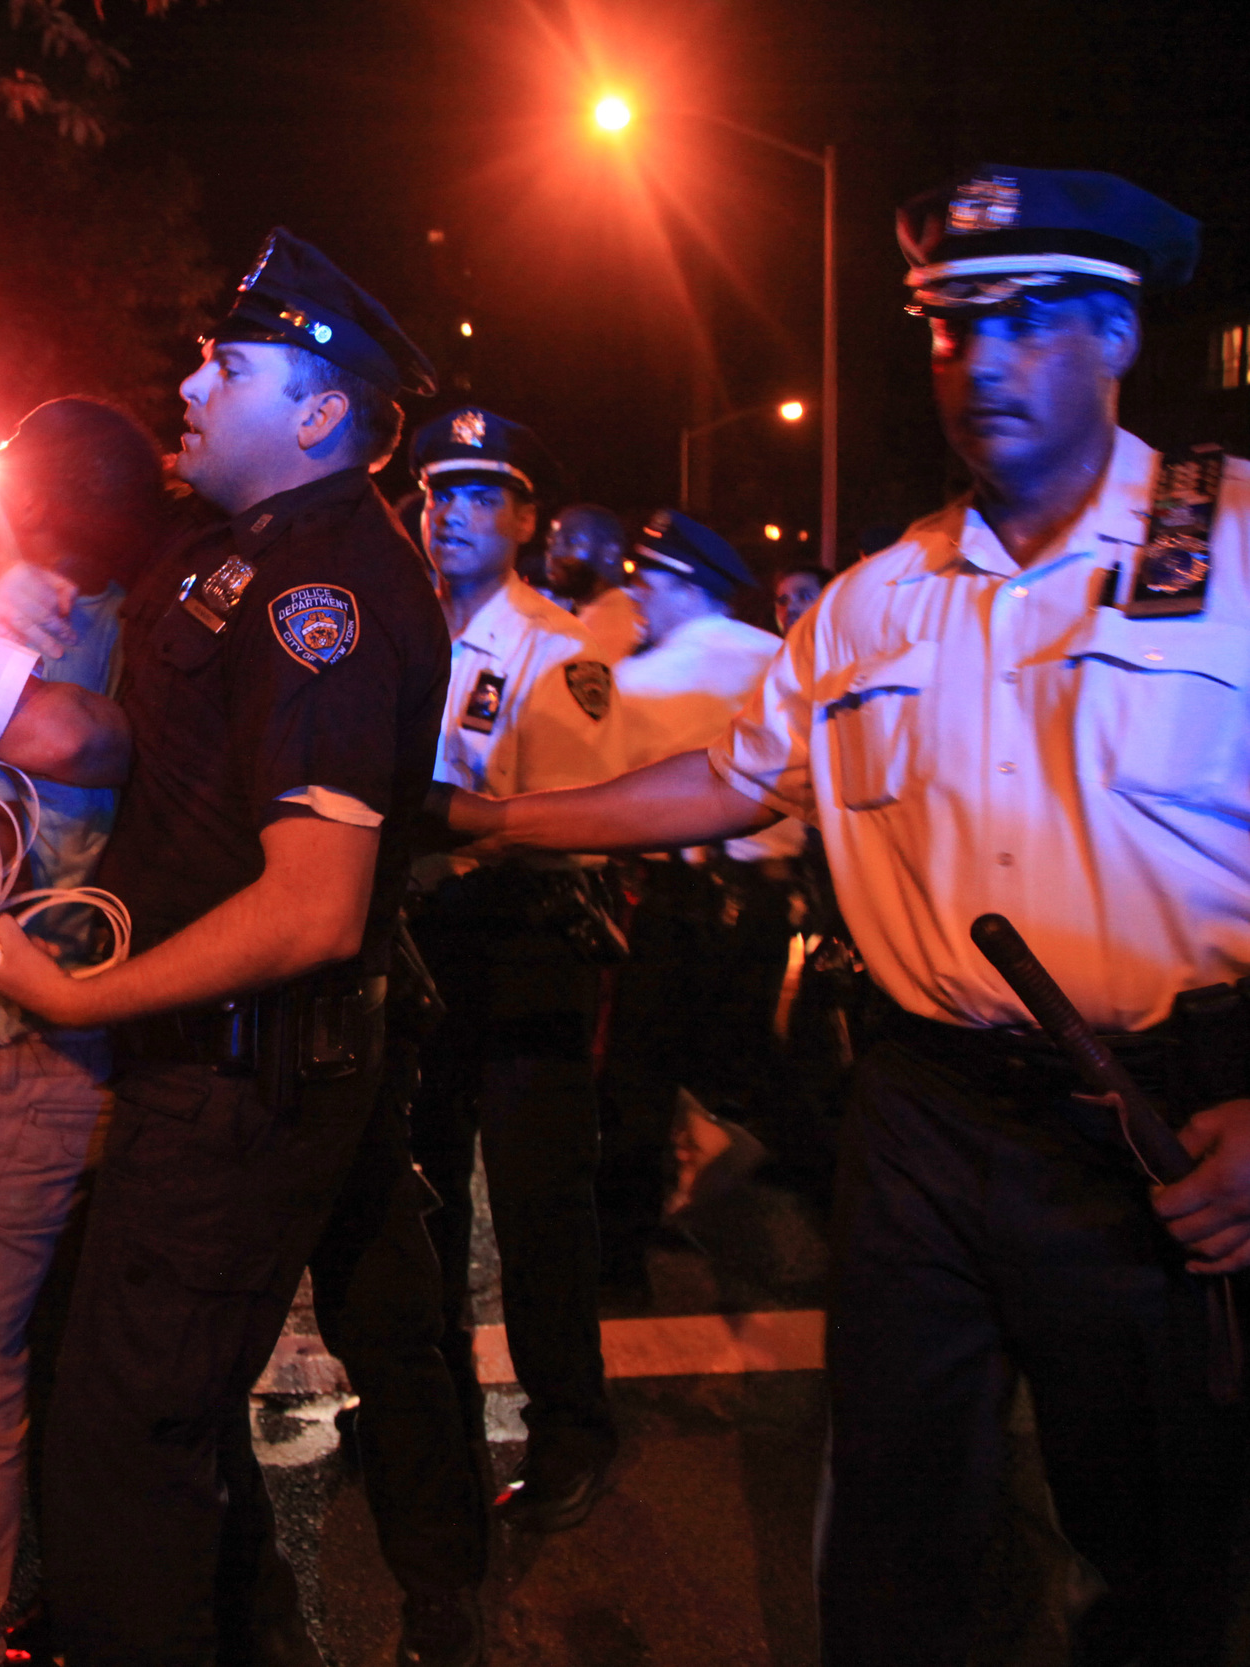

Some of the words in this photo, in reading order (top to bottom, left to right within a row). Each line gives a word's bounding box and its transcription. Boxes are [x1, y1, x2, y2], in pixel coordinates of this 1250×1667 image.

[290, 588, 333, 603] POLICE
[278, 597, 349, 620] DEPARTMENT
[283, 630, 304, 653] CITY
[302, 651, 317, 662] OF
[330, 644, 347, 665] NEW
[344, 619, 355, 643] YORK
